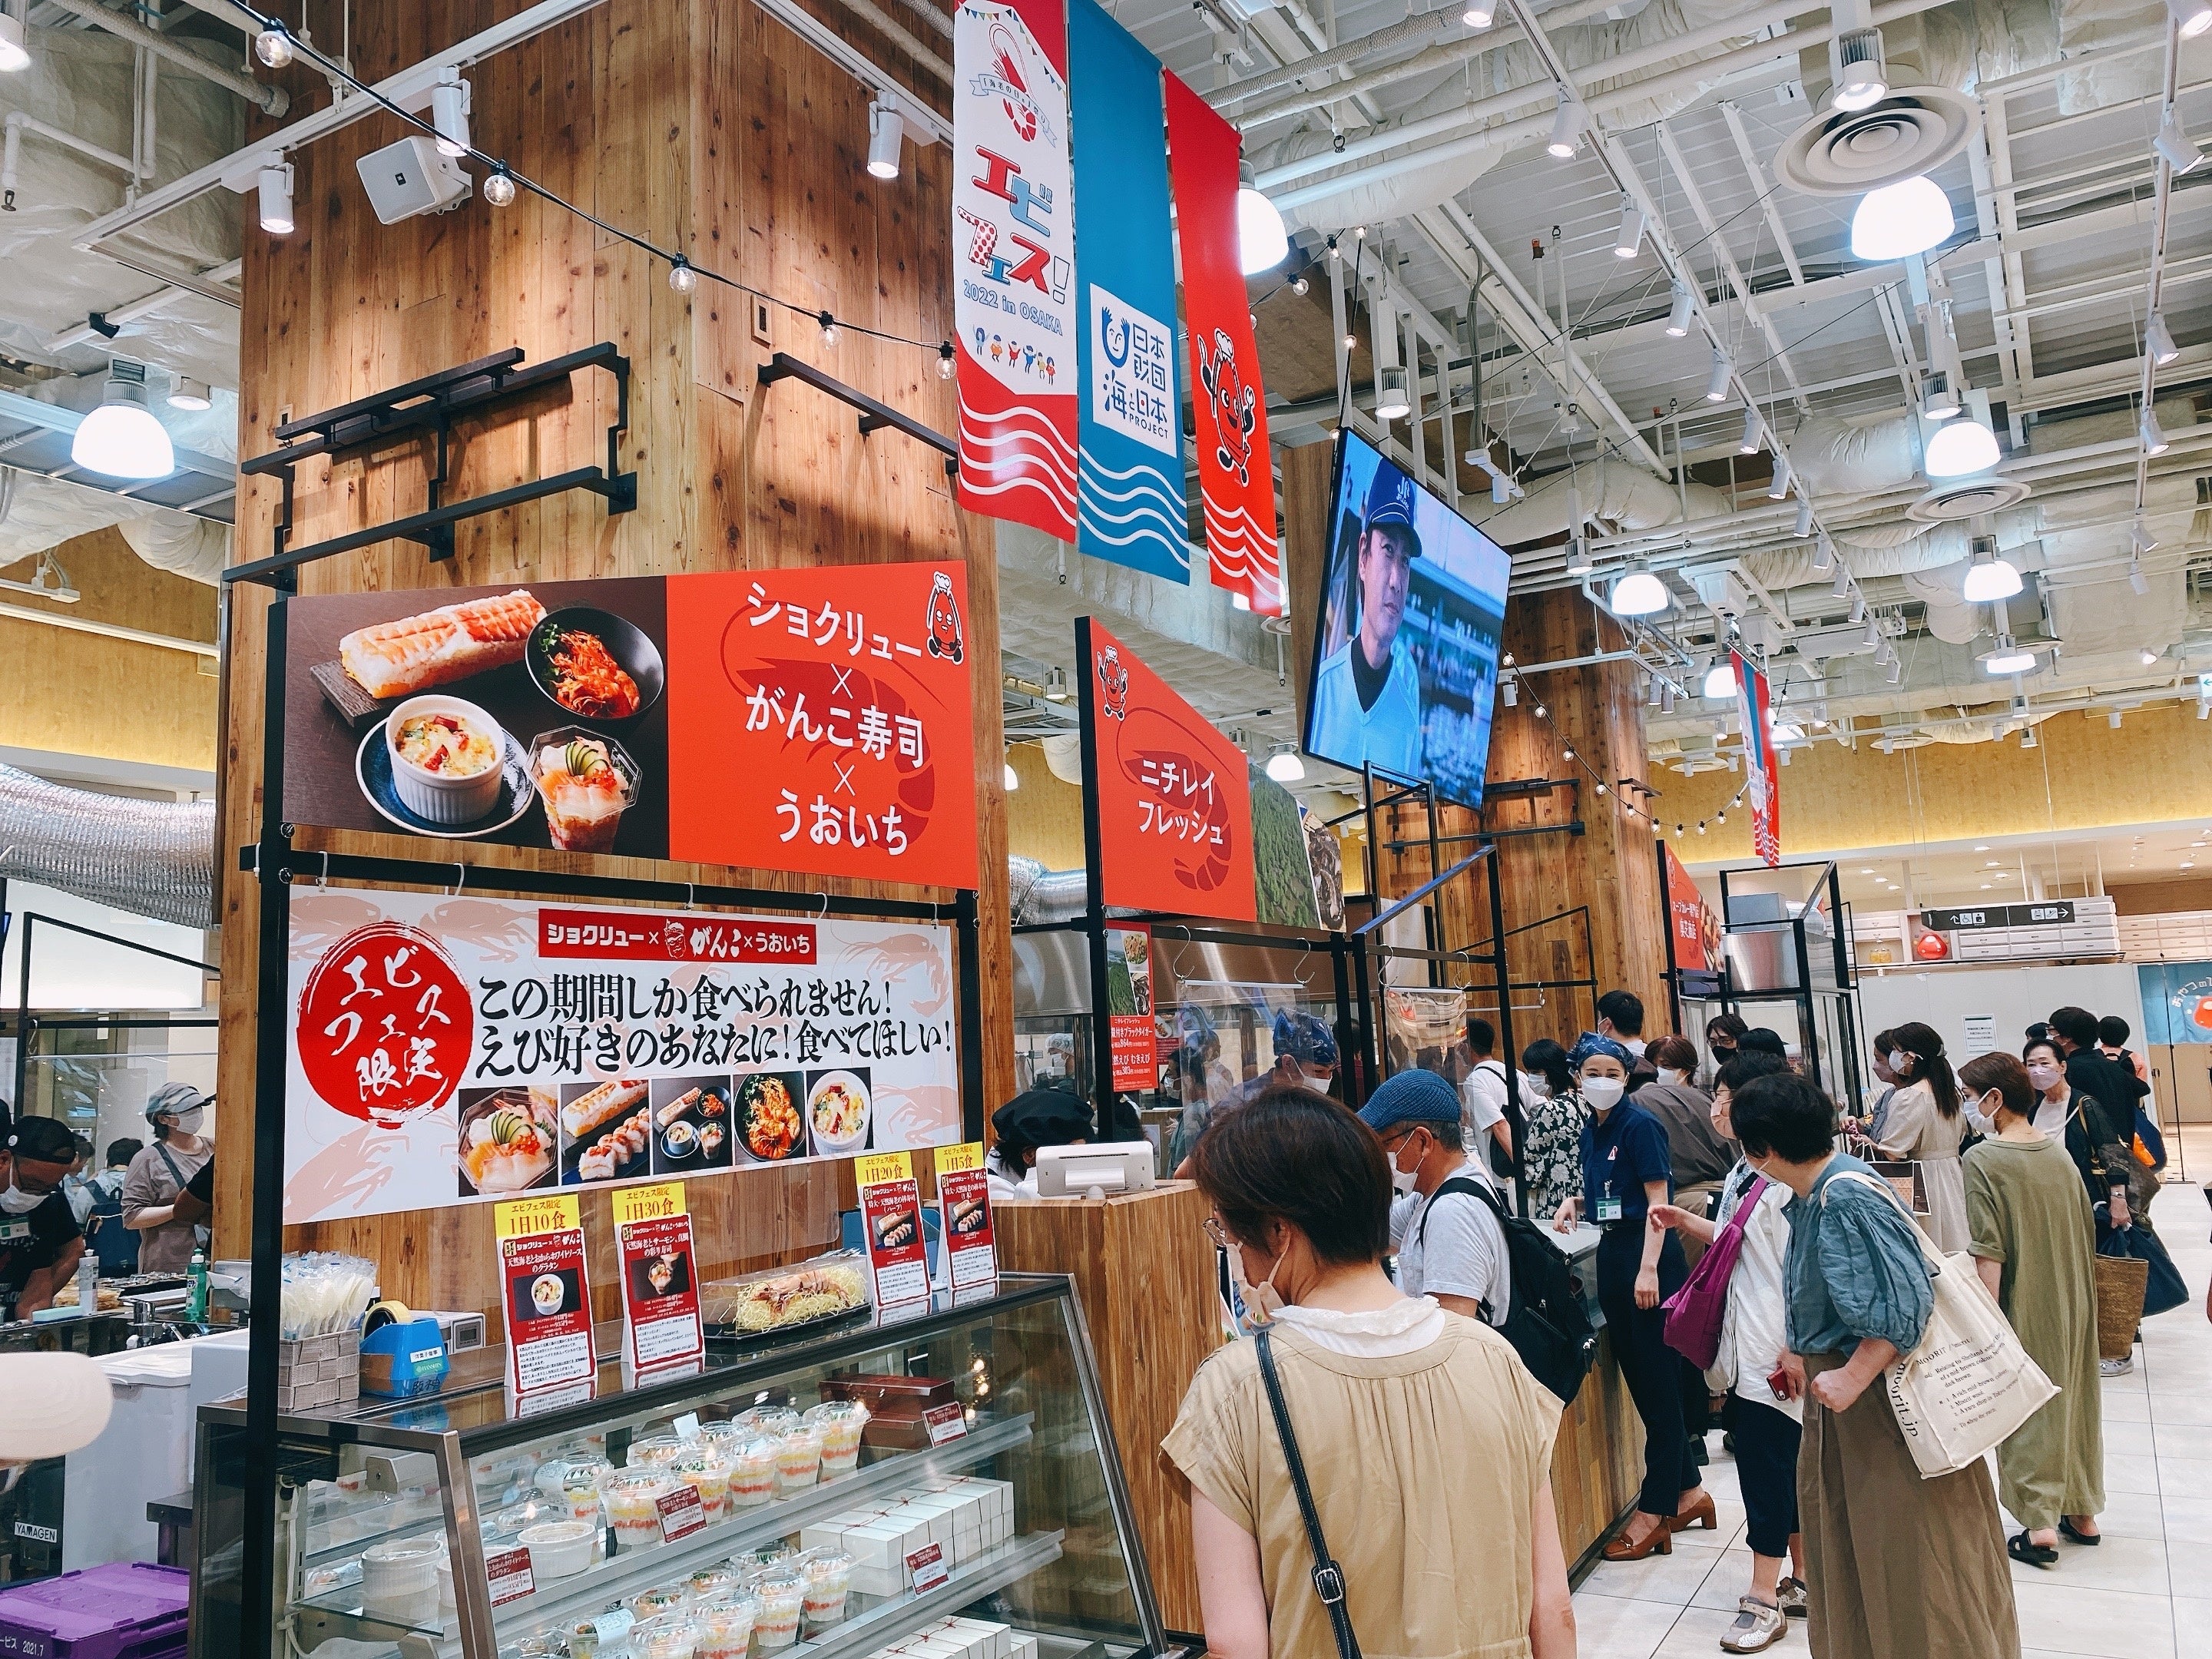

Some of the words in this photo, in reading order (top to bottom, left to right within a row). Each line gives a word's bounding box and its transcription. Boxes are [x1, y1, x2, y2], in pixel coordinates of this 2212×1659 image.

[971, 145, 1052, 237] エビ
[963, 279, 998, 308] 2022
[1002, 294, 1016, 316] in
[1020, 301, 1063, 337] OSAKA
[1132, 322, 1165, 360] 日本
[1134, 353, 1166, 392] 財団
[1102, 369, 1168, 425] 海と日本
[1129, 413, 1168, 440] PROJECT
[747, 581, 922, 661] ショクリュー
[745, 684, 924, 769] がんこ寿司
[1141, 759, 1216, 805] ニチレイ
[775, 787, 908, 856] うおいち
[1138, 800, 1224, 845] フレッシュ
[342, 945, 419, 1005] エビ
[479, 972, 892, 1025] この期間しか食べられません!
[355, 1038, 442, 1103] 限定
[866, 1155, 899, 1165] エビフェス限定
[944, 1145, 973, 1155] エビフェス限定
[945, 1154, 973, 1171] 1日5食
[865, 1164, 903, 1183] 1日20食
[512, 1198, 561, 1213] エビフェス限定
[625, 1198, 674, 1220] 1日30食
[626, 1186, 671, 1200] エビフェス限定
[510, 1210, 566, 1235] 1日10食
[531, 1261, 559, 1273] のグラタン
[1916, 1347, 1947, 1366] MOORIT
[1891, 1363, 1919, 1438] moorit.jp
[16, 1524, 55, 1541] YAMAGEN
[22, 1641, 45, 1657] 2021.7
